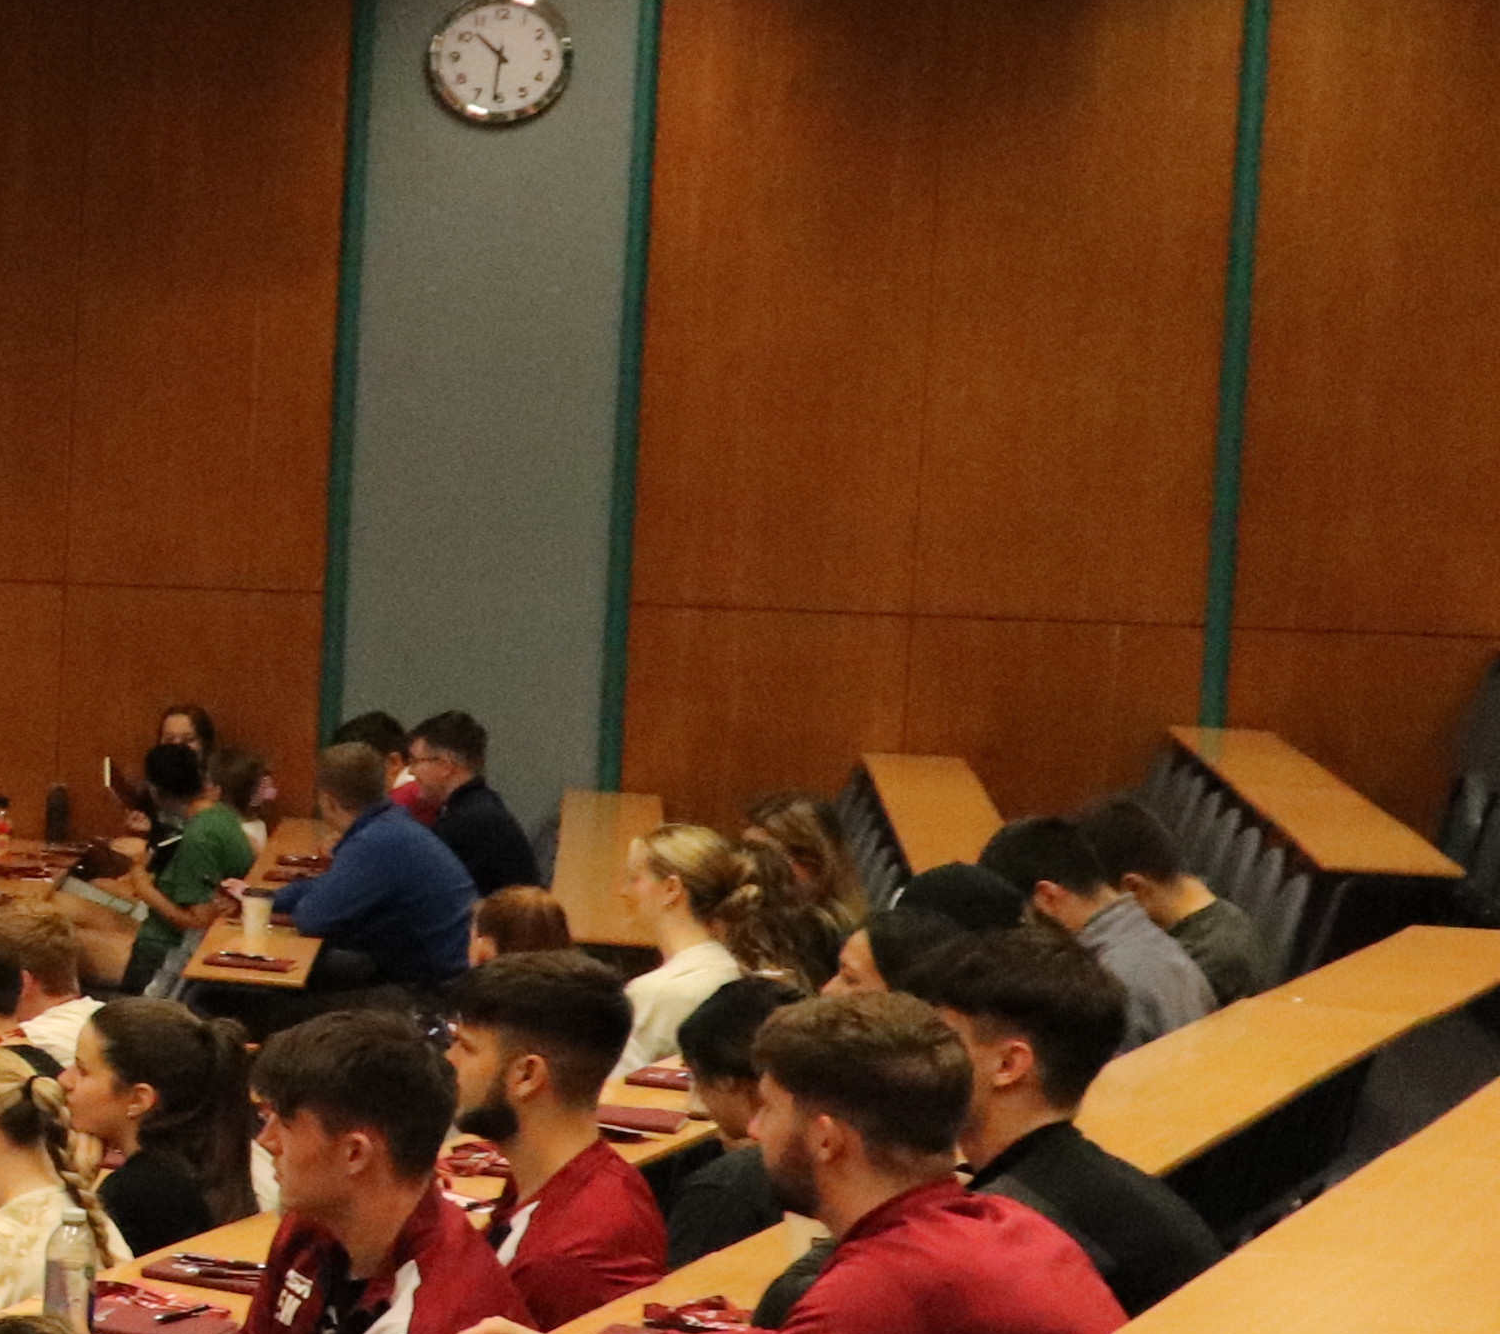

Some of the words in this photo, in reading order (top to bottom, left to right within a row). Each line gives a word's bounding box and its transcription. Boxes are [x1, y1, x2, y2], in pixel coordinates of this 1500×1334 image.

[494, 9, 510, 20] 12
[458, 32, 474, 43] 10
[534, 30, 546, 41] 2
[542, 50, 552, 60] 3
[474, 88, 483, 99] 7
